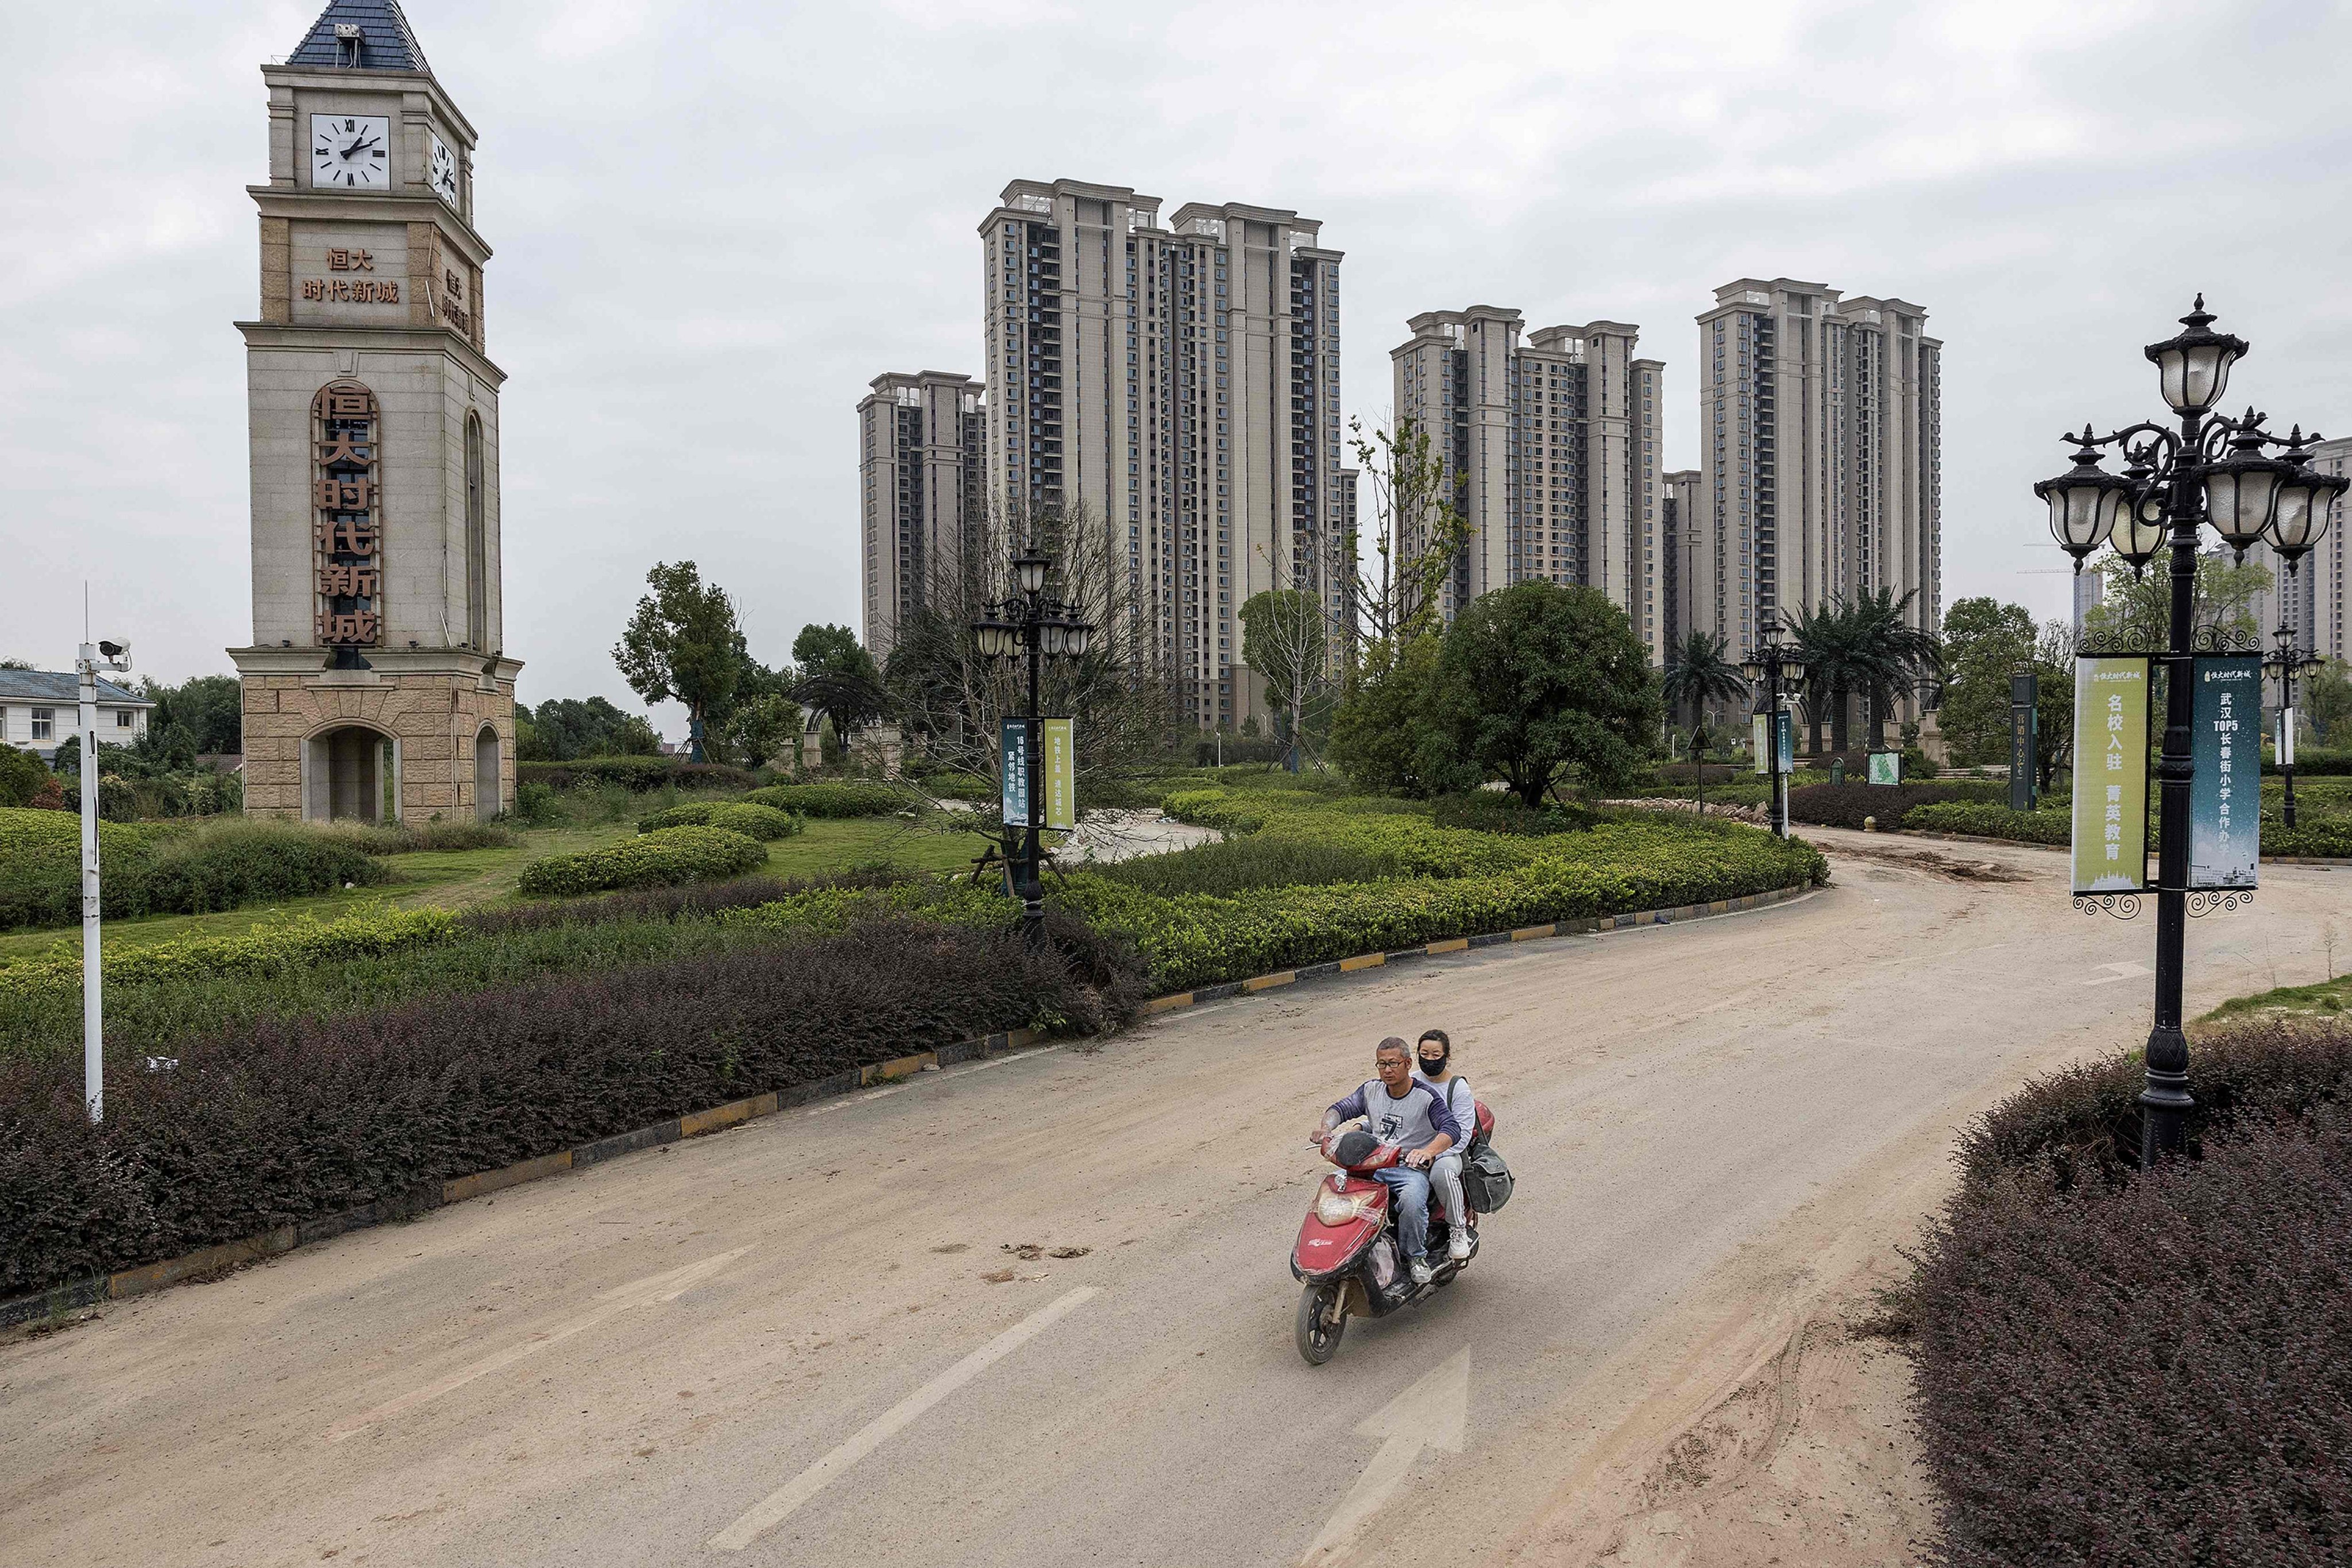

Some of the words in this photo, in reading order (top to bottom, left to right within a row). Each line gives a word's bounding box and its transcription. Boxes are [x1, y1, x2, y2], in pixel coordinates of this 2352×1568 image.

[345, 119, 355, 133] XII
[327, 248, 373, 271] 恒大
[303, 279, 400, 304] 时代新城
[317, 387, 376, 643] 恒大时代新城
[2211, 669, 2251, 679] 恒大时代新城
[2106, 694, 2123, 771] 名校入驻
[1017, 736, 1026, 809] 16号线职教园站
[2104, 785, 2121, 860] 菁英教育
